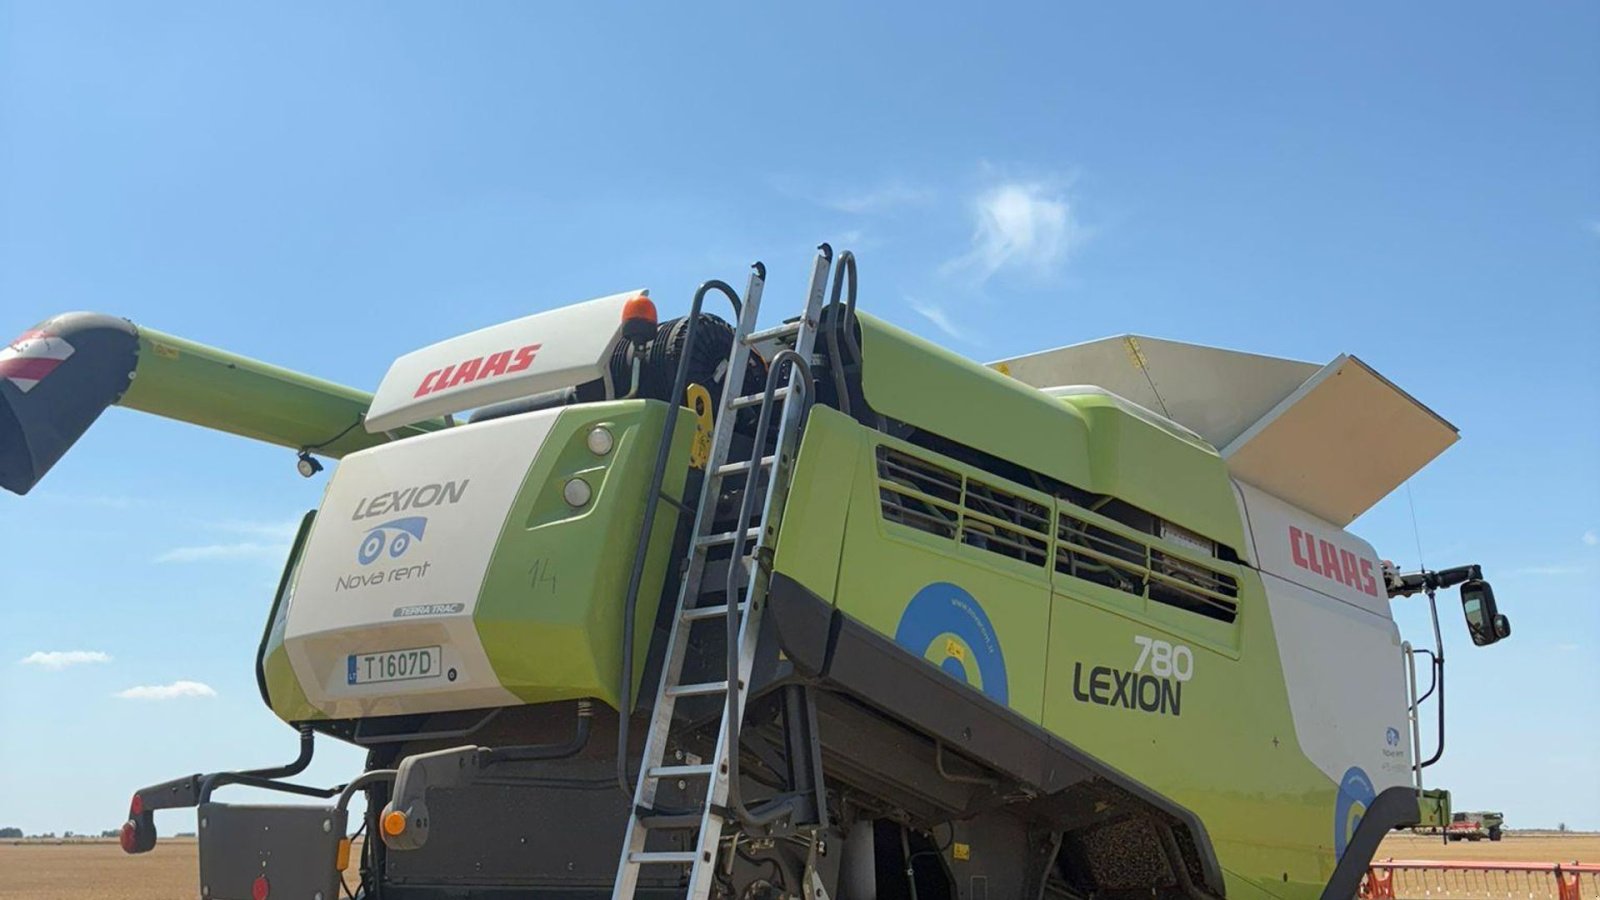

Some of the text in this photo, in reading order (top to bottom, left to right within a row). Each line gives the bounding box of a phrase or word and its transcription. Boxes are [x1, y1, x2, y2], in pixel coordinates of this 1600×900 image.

[413, 344, 542, 398] CLAAS
[352, 479, 469, 521] LEXION
[335, 561, 431, 592] Nova rent
[528, 558, 556, 594] 14
[1289, 525, 1378, 597] CLAAS
[400, 604, 458, 616] TERRA TRAC
[364, 651, 432, 679] T1607D
[1134, 635, 1194, 681] 780
[1073, 661, 1182, 716] LEXION
